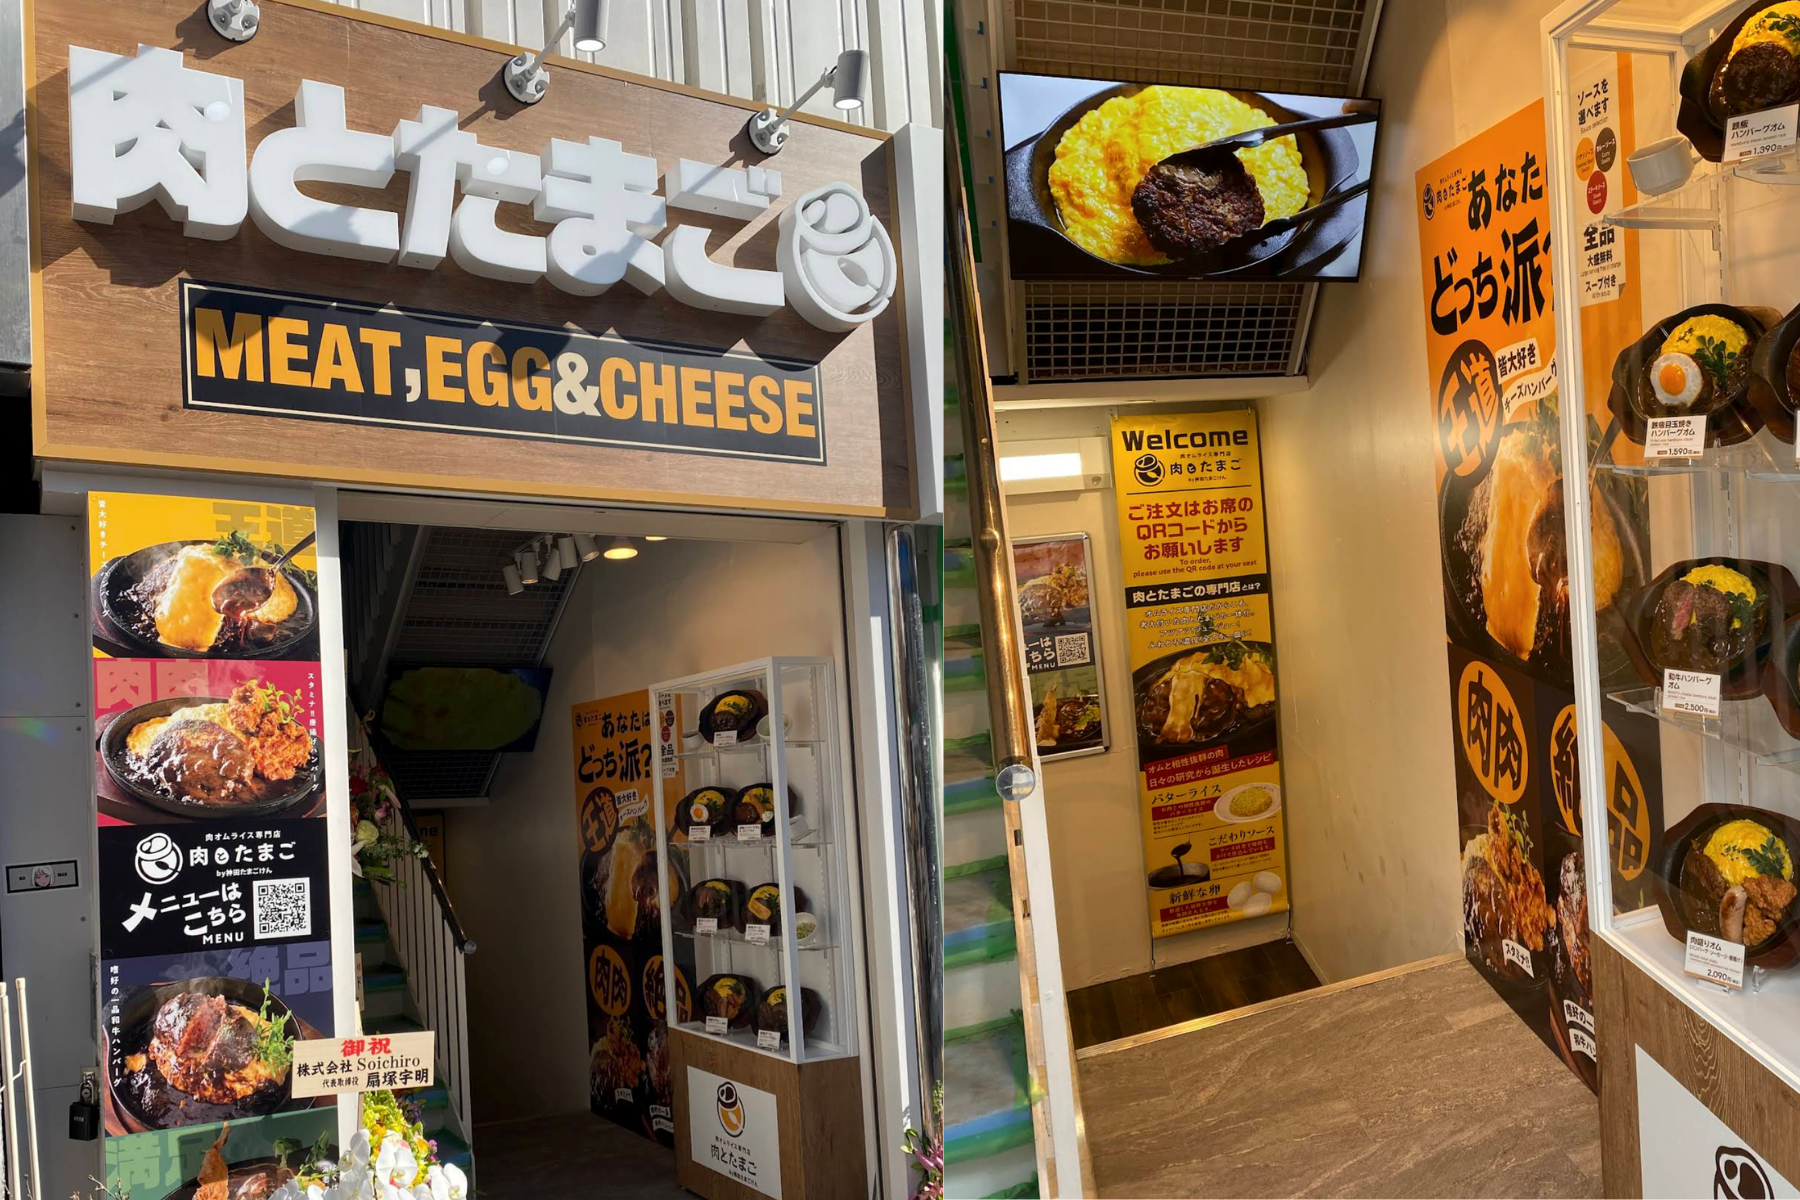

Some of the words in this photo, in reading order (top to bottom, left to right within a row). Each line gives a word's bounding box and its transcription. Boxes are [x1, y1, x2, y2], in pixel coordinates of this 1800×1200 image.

[1577, 78, 1609, 107] ソースを
[1578, 97, 1609, 125] 選べます
[1731, 122, 1785, 139] ハンバーグオム
[1732, 119, 1748, 131] 鉄板
[69, 43, 785, 317] 肉とたまご
[1468, 151, 1548, 231] あなた
[1583, 223, 1615, 252] 全品
[1587, 248, 1613, 268] 大盛無料
[1586, 274, 1617, 293] スープ付き
[1498, 343, 1536, 379] 皆大好き
[1122, 429, 1248, 451] Welcome
[1651, 428, 1696, 437] ハンバーグオム
[1170, 458, 1242, 475] 肉とたまご
[1128, 497, 1254, 521] ご注文はお席の
[1136, 516, 1248, 540] QRコードから
[1144, 536, 1244, 560] お願いします
[1133, 570, 1157, 578] please
[1186, 565, 1197, 573] QR
[1198, 563, 1216, 571] code
[1225, 561, 1241, 569] your
[1031, 661, 1056, 671] MENU
[1668, 672, 1712, 685] 和牛ハンバーグ
[1468, 669, 1522, 791] 肉肉
[1148, 749, 1224, 774] オムと相性抜群の肉
[1149, 753, 1272, 788] 日々の研究から誕生したレシピ
[1152, 784, 1222, 804] バターライス
[205, 830, 281, 842] 肉オムライス専門店
[1208, 825, 1275, 846] こだわりソース
[189, 841, 297, 867] 肉とたまご
[1169, 884, 1221, 904] 新鮮な卵
[122, 882, 242, 933] メニューは
[184, 903, 247, 936] こちら
[202, 931, 245, 945] MENU
[1690, 936, 1722, 951] 肉盛りオム
[340, 1037, 392, 1057] 御祝
[297, 1059, 353, 1077] 株式会社
[357, 1054, 420, 1072] Soichiro
[322, 1076, 359, 1088] 代表取締役
[711, 1144, 757, 1176] 肉とたまご
